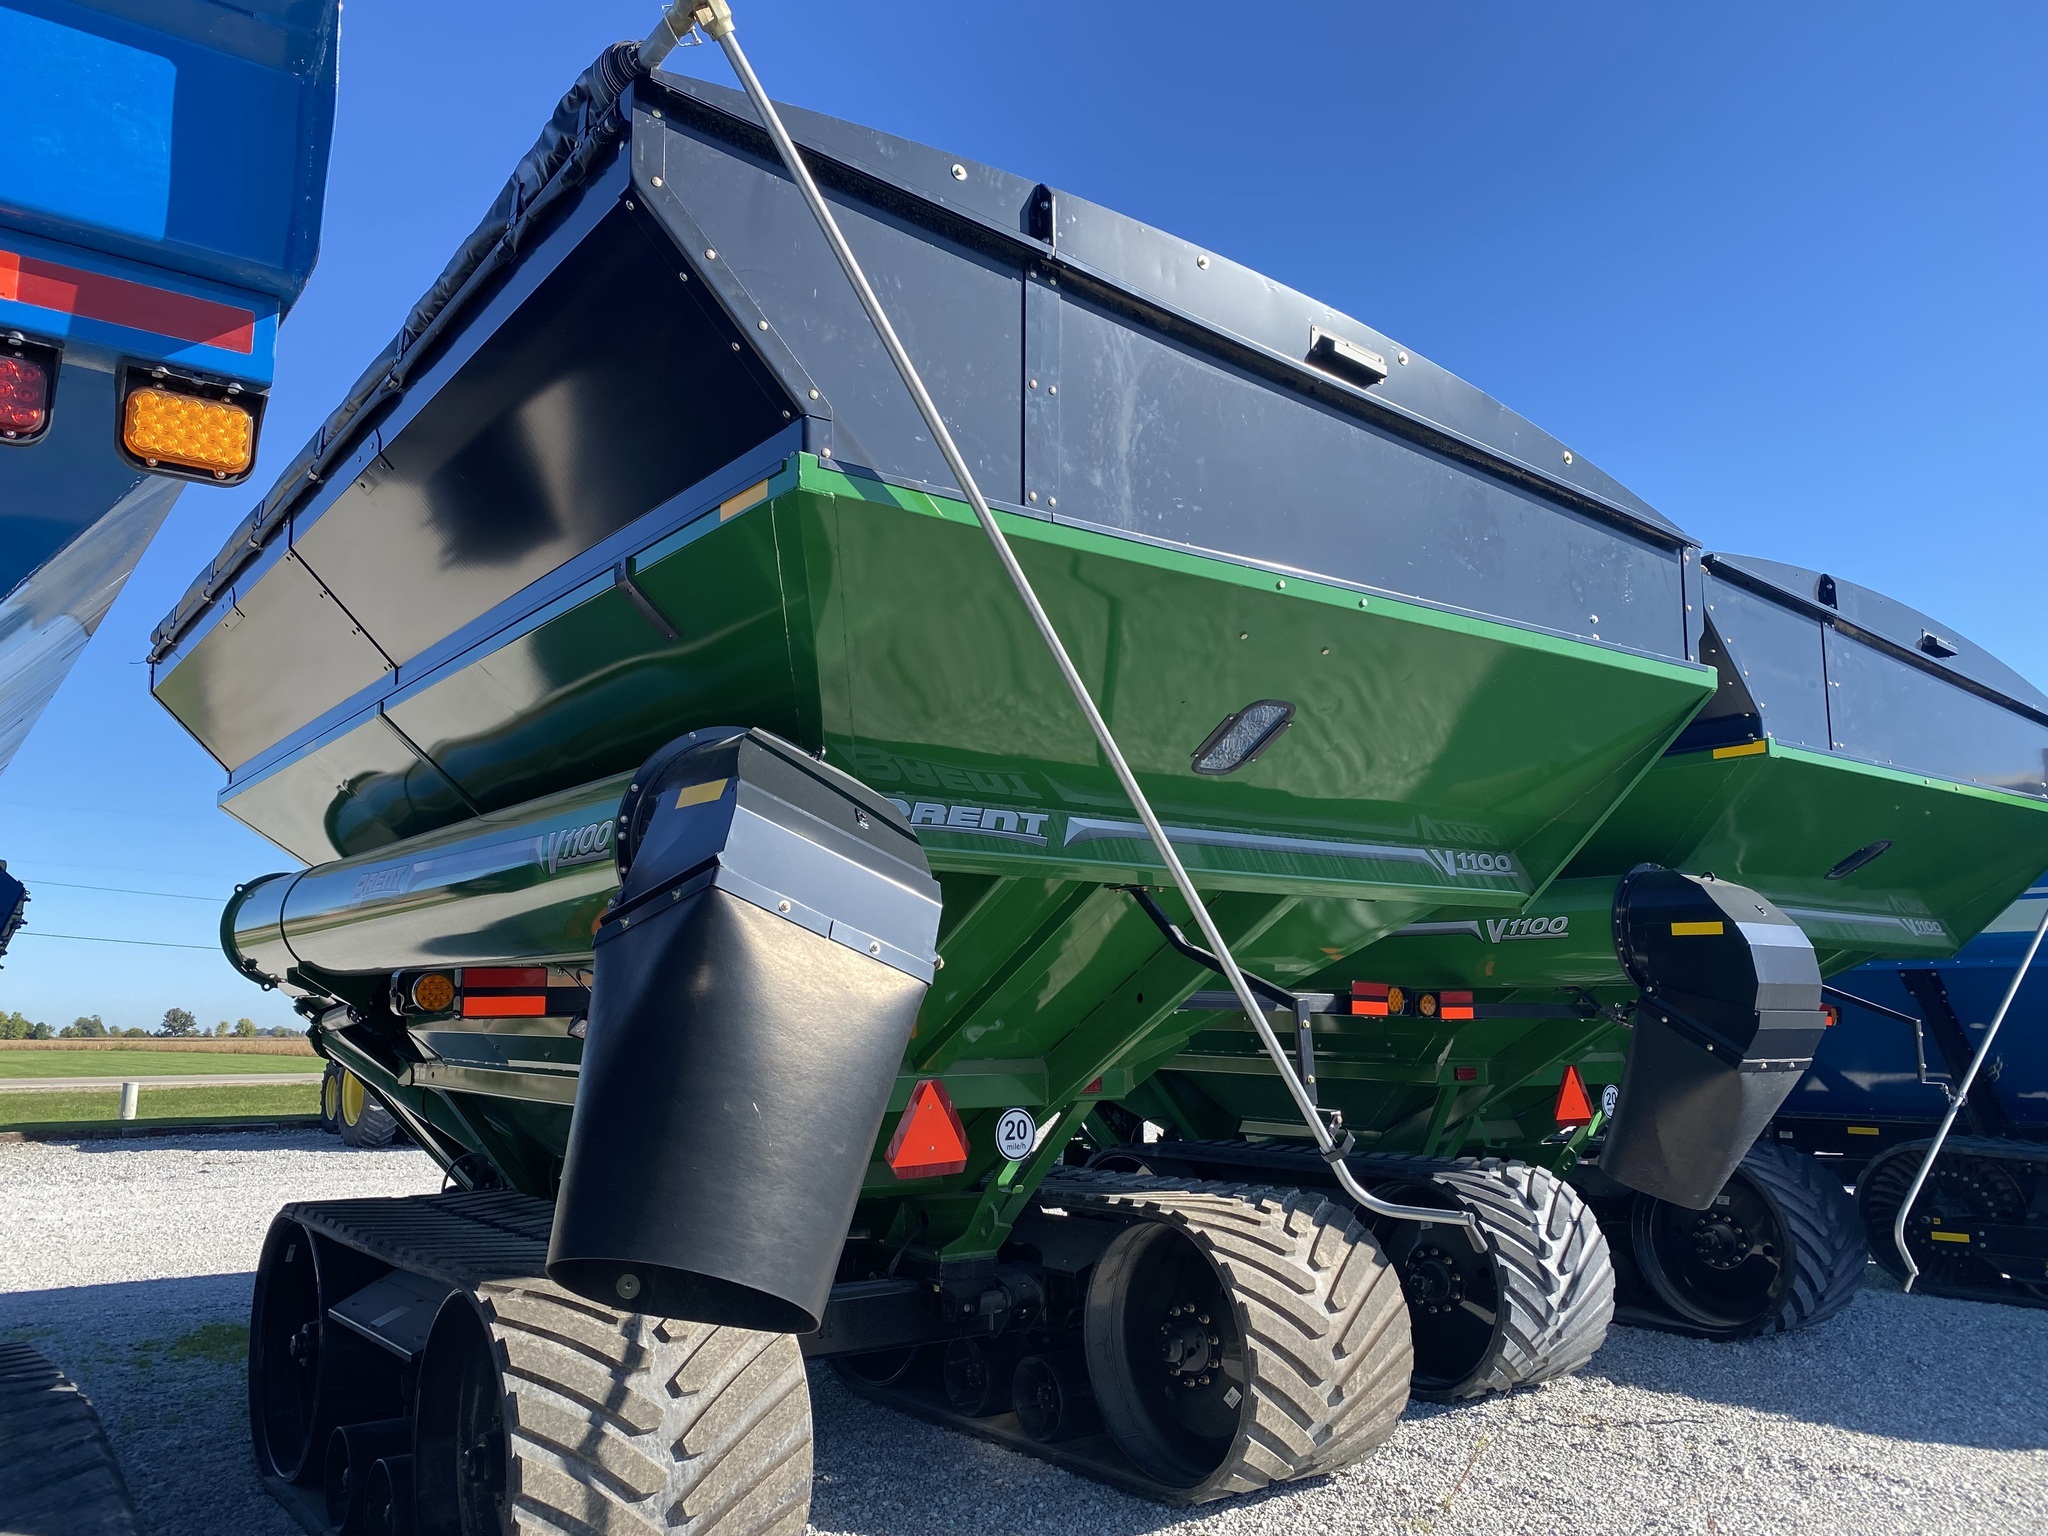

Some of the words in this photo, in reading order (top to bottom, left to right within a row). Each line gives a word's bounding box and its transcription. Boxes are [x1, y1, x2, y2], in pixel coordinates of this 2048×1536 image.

[548, 821, 613, 875] V1100
[1430, 849, 1512, 876] V1100
[351, 865, 409, 900] BRENT
[1486, 916, 1568, 943] V1100
[1902, 918, 1942, 936] V1100
[1005, 1119, 1027, 1140] 20
[1006, 1142, 1026, 1150] mile/h
